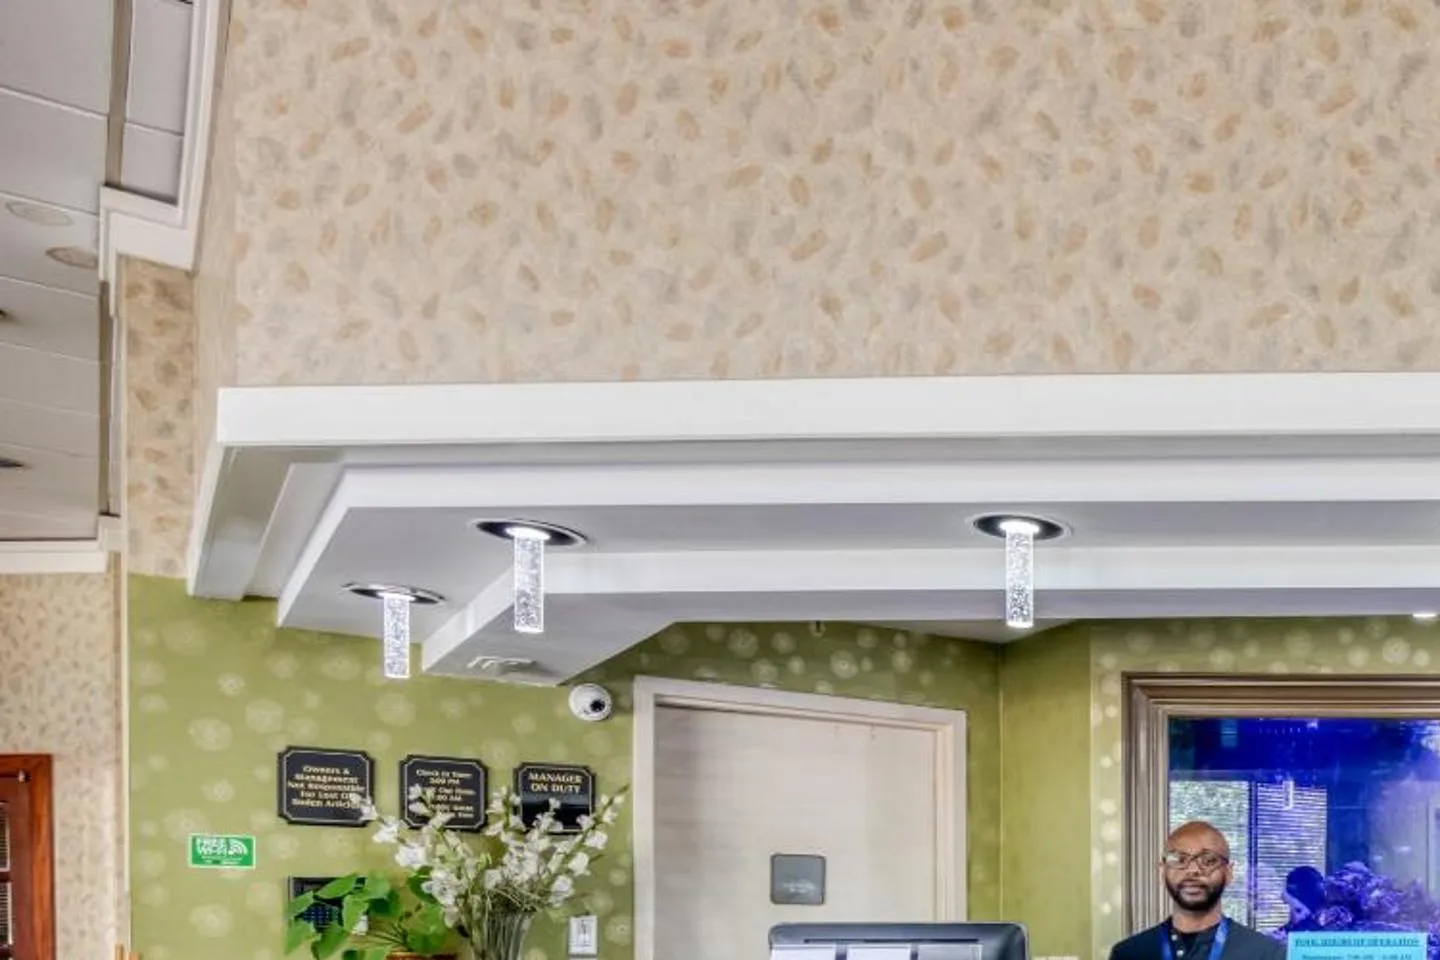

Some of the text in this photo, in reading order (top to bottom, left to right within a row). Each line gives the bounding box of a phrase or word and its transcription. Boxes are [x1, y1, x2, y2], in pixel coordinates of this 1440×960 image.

[294, 773, 358, 784] Management
[528, 771, 583, 784] MANAGER
[531, 782, 581, 794] ON DUTY
